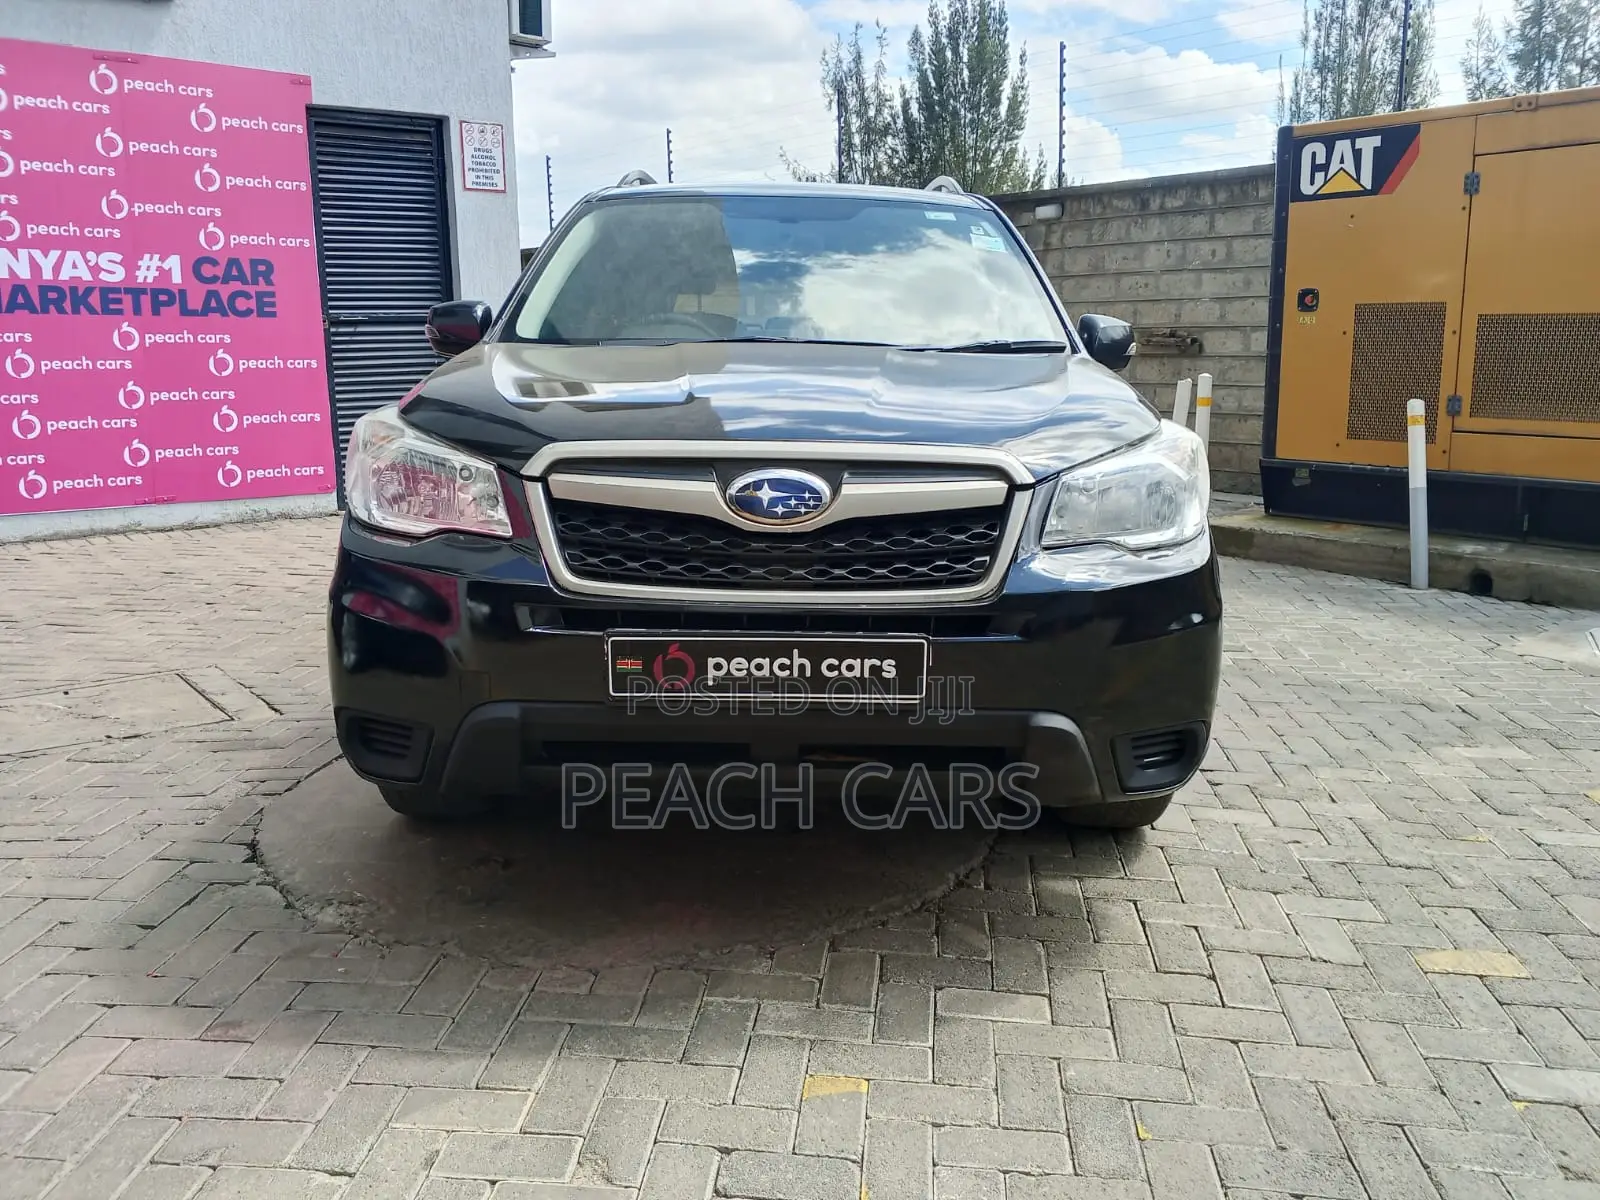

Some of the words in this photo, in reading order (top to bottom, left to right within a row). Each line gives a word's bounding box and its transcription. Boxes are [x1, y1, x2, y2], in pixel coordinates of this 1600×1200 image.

[123, 78, 175, 94] peach
[178, 85, 214, 98] cars
[13, 94, 69, 110] peach
[71, 101, 110, 114] cars
[221, 116, 268, 131] peach
[271, 122, 304, 134] cars
[128, 140, 180, 155] peach
[183, 146, 218, 158] cars
[19, 158, 74, 175] peach
[78, 164, 116, 177] cars
[471, 160, 497, 168] TOBACCO
[1299, 134, 1382, 196] CAT
[225, 175, 272, 190] peach
[275, 180, 307, 192] cars
[134, 200, 184, 217] peach
[187, 206, 222, 217] cars
[26, 221, 80, 239] peach
[83, 227, 121, 239] cars
[229, 232, 276, 248] peach
[279, 237, 311, 248] cars
[135, 253, 183, 284] #1
[191, 256, 275, 286] CAR
[0, 283, 278, 318] ARKETPLACE
[144, 329, 194, 347] peach
[197, 334, 231, 344] cars
[40, 355, 93, 375] peach
[96, 359, 133, 370] cars
[238, 355, 284, 373] peach
[286, 359, 318, 369] cars
[0, 393, 39, 405] cars
[149, 387, 198, 406] peach
[201, 390, 236, 400] cars
[46, 415, 99, 435] peach
[102, 418, 138, 429] cars
[243, 410, 287, 428] peach
[290, 413, 321, 423] cars
[6, 454, 45, 465] cars
[155, 443, 203, 462] peach
[206, 446, 240, 456] cars
[246, 464, 291, 483] peach
[293, 466, 324, 476] cars
[53, 474, 104, 494] peach
[107, 475, 143, 487] cars
[707, 648, 811, 686] peach
[820, 656, 897, 679] cars
